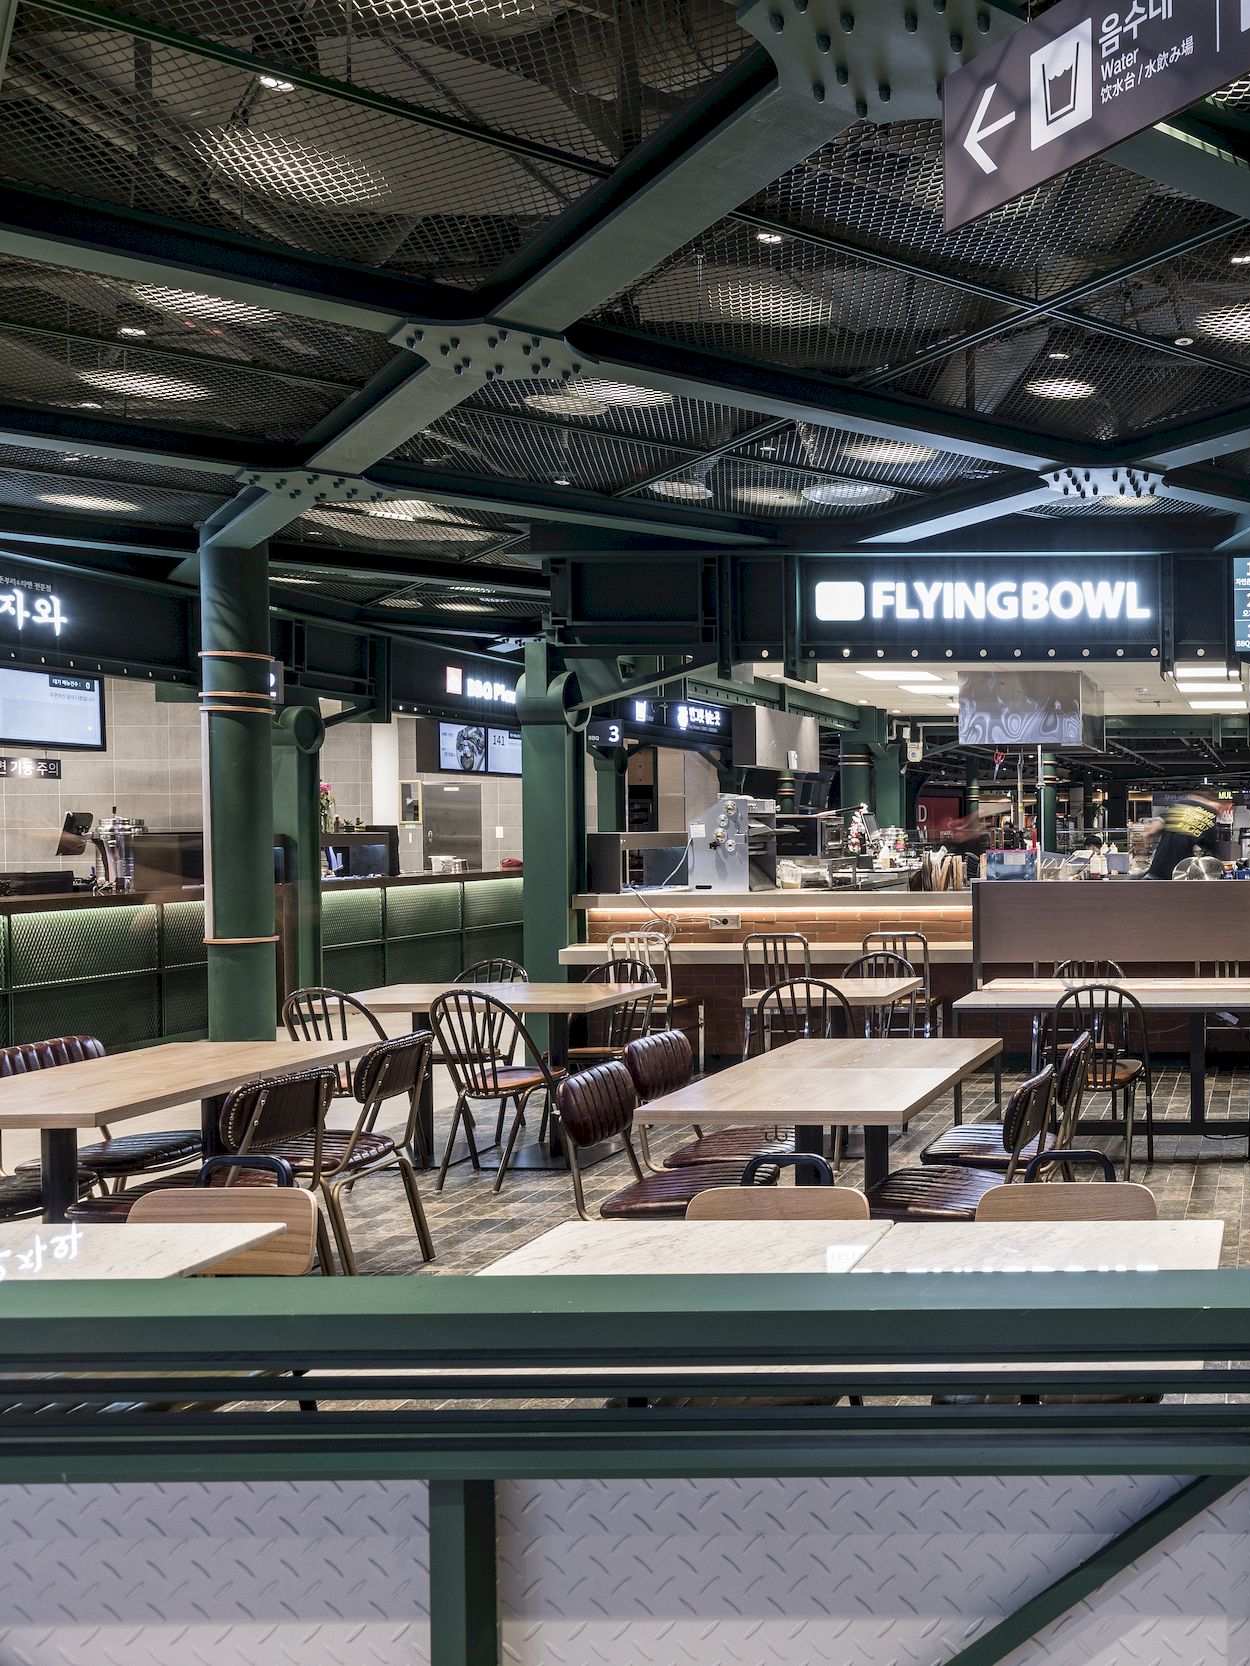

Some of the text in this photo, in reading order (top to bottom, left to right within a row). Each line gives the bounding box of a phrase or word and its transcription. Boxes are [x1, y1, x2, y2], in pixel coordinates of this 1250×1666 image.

[1101, 48, 1139, 81] Water
[871, 580, 1152, 620] FLYINGBOWL
[492, 734, 505, 746] 141
[608, 725, 620, 743] 3
[36, 762, 59, 777] 주의
